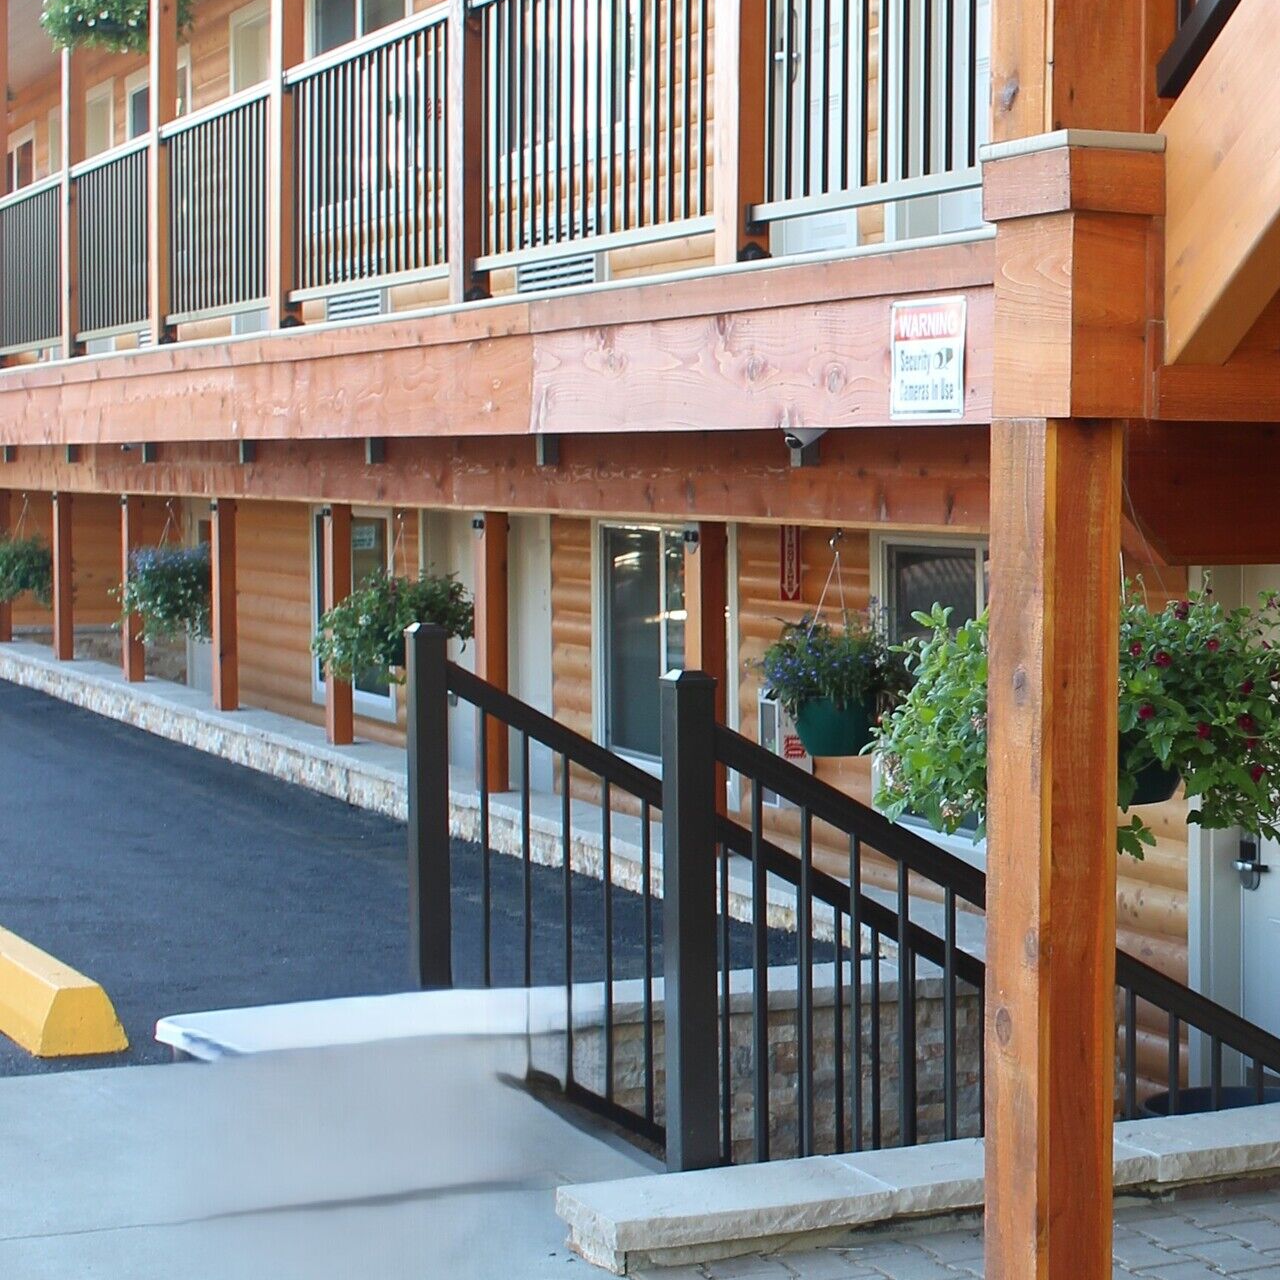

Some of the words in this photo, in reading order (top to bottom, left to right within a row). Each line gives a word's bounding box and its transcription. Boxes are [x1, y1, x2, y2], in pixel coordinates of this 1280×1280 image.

[899, 311, 958, 337] WARNING
[900, 349, 931, 375] Security
[900, 379, 929, 401] Cameras
[941, 377, 954, 400] Use
